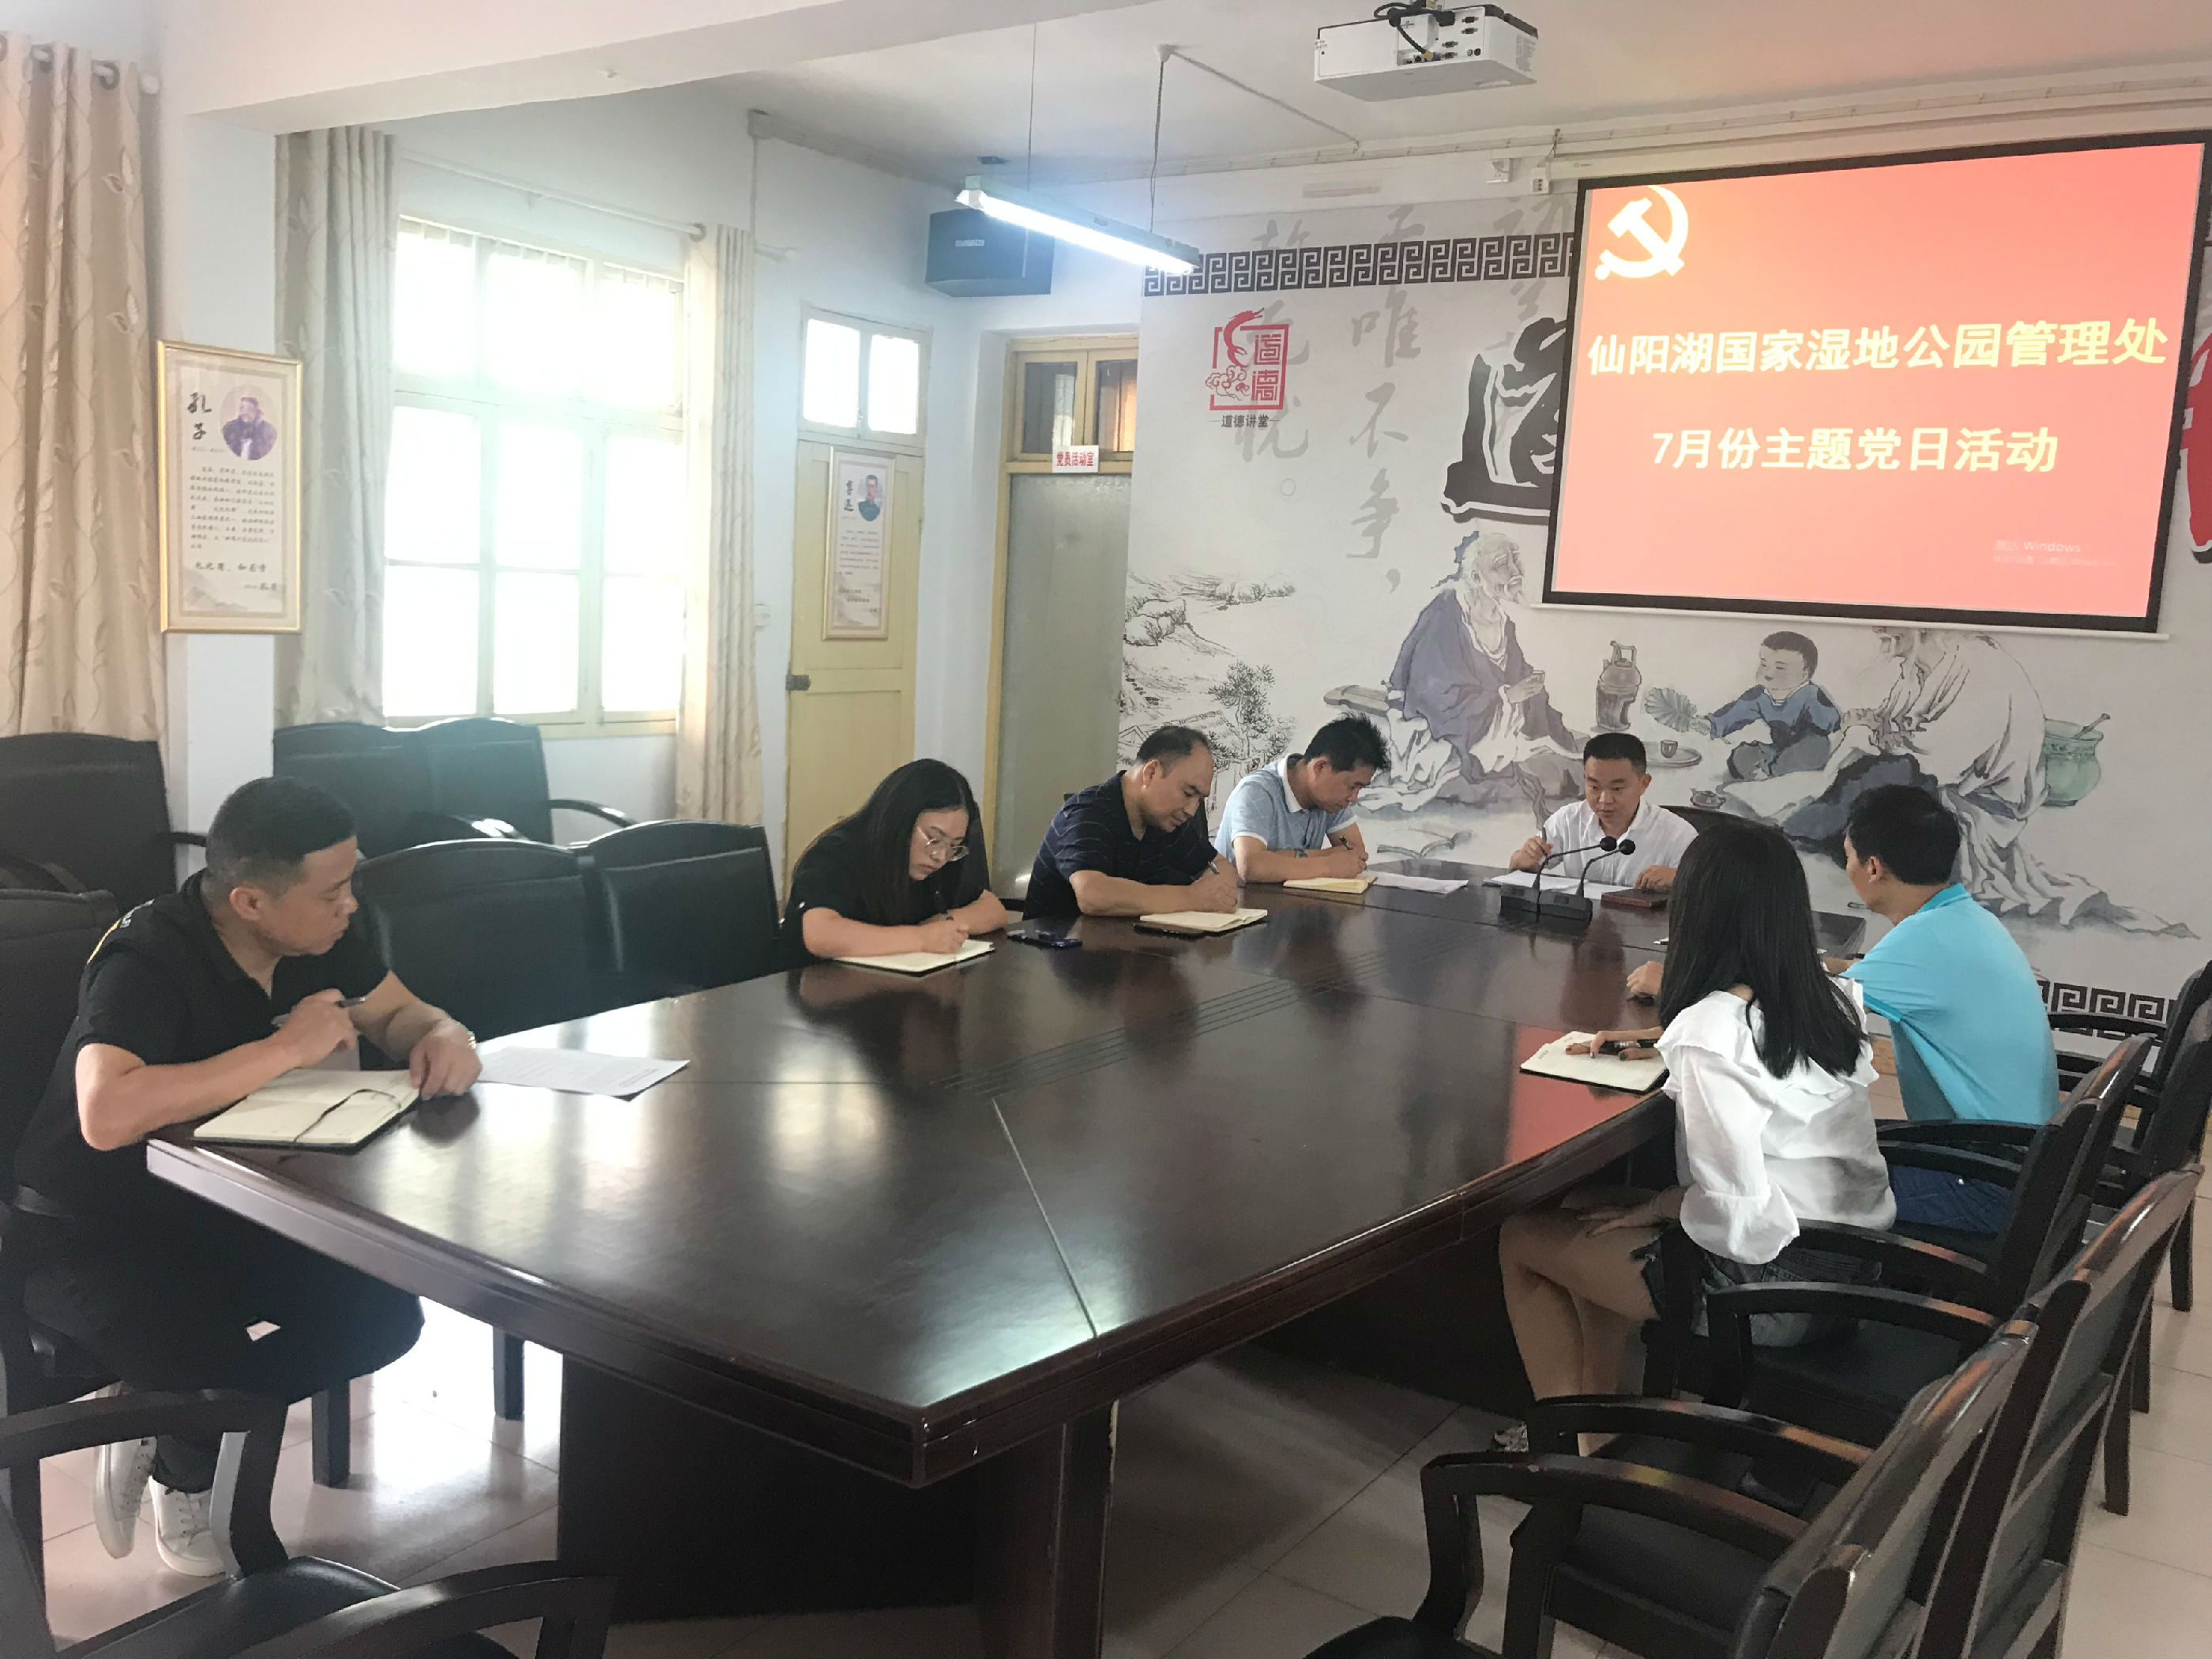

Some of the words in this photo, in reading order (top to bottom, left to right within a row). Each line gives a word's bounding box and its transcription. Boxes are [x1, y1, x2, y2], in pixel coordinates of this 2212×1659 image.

[1588, 318, 2169, 375] 仙阳湖国家湿地公园管理处
[1221, 413, 1270, 428] 道德讲堂
[1056, 451, 1094, 467] 党员活动室
[1653, 427, 2060, 472] 7月份主题党日活动
